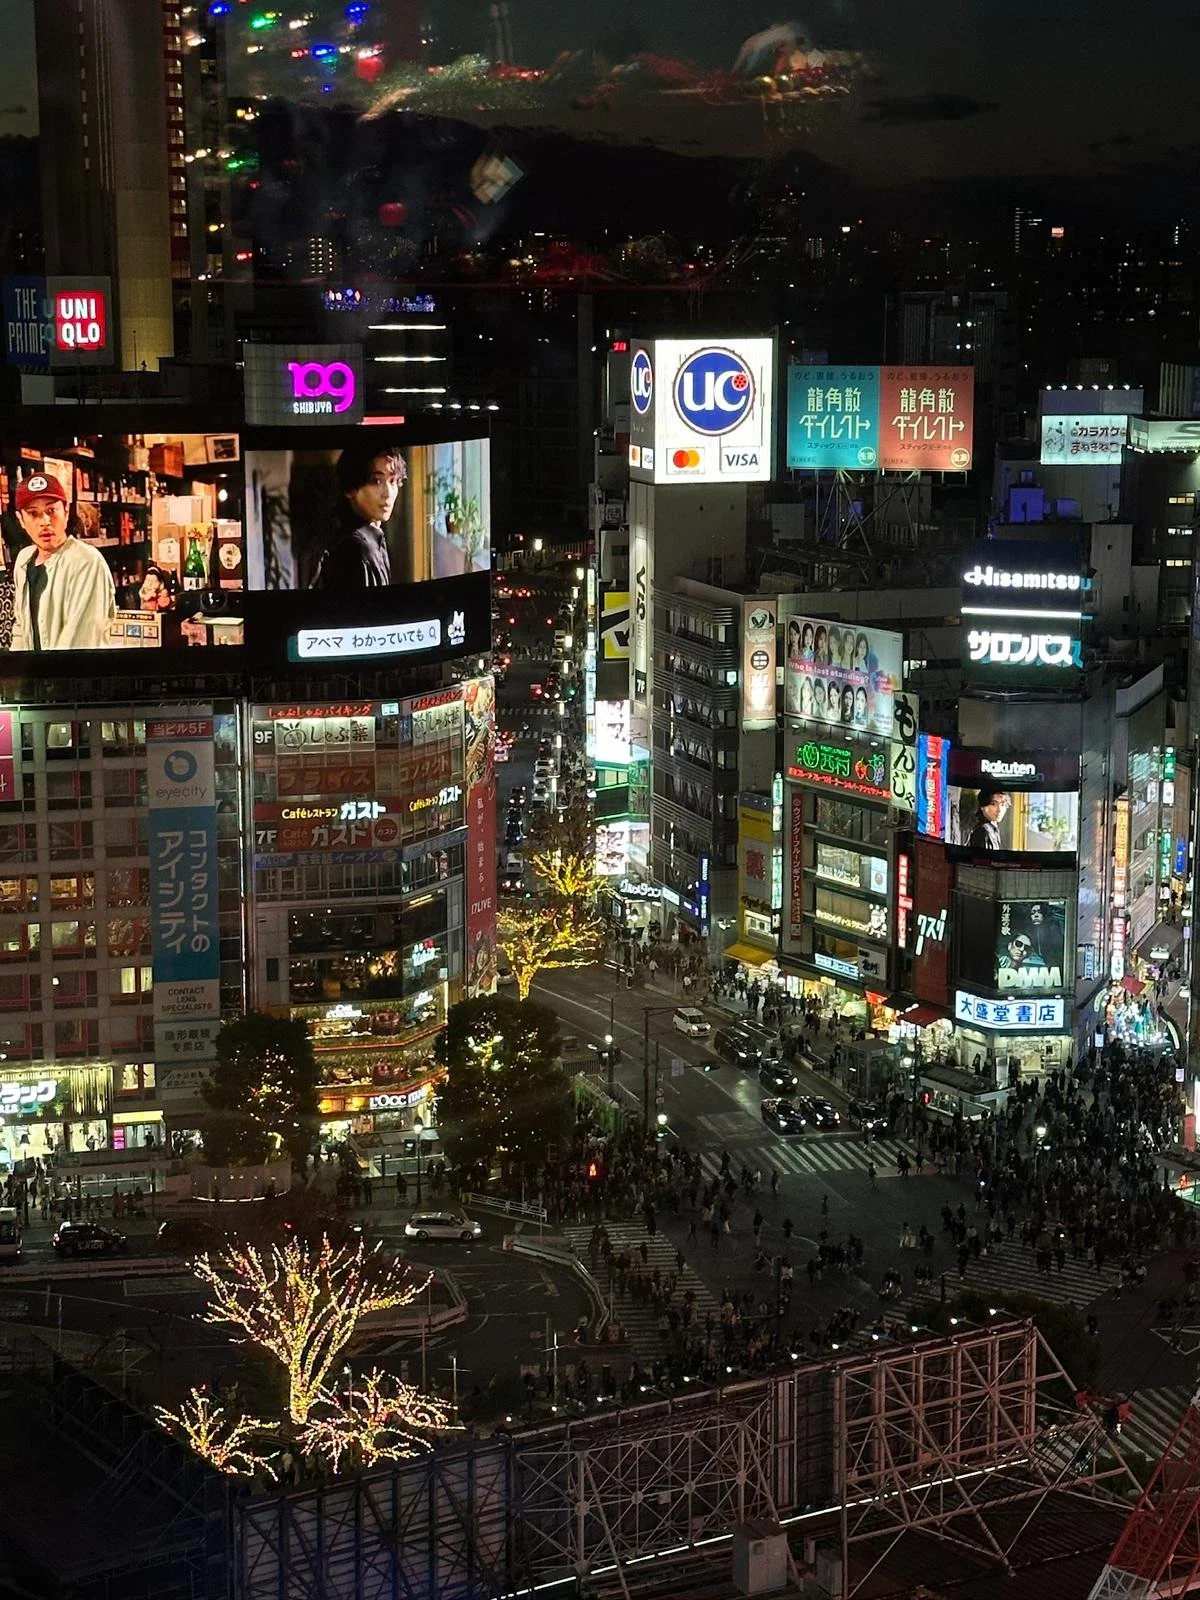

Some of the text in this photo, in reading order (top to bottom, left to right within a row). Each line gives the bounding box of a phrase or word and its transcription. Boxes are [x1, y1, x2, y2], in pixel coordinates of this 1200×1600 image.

[14, 287, 37, 320] THE
[60, 298, 97, 320] UNI
[8, 321, 47, 355] PRIME
[61, 321, 101, 347] QLO
[287, 361, 356, 413] 109
[683, 370, 747, 412] UC
[293, 400, 333, 414] SHIBUYA
[807, 387, 862, 412] 龍角散
[900, 388, 955, 413] 龍角散
[799, 414, 871, 440] ダイレクト
[892, 415, 965, 441] ダイレクト
[1078, 426, 1121, 437] カラオケ
[1070, 441, 1119, 454] まねきねこ
[725, 453, 759, 467] VISA
[964, 565, 1080, 590] Hisamitsu
[305, 627, 425, 650] アベマ わかっていても
[967, 630, 1073, 665] サロンパス
[153, 722, 207, 736] 当ビル5F
[254, 730, 272, 744] 9F
[310, 720, 369, 744] しゃぶ葉
[981, 759, 1036, 776] Rakuten
[156, 786, 208, 800] eyecity
[438, 785, 462, 807] ガスト
[340, 801, 386, 820] ガスト
[256, 829, 277, 845] 7F
[311, 825, 368, 848] ガスト
[158, 830, 188, 955] アイシティ
[189, 830, 211, 954] コンタクトの
[915, 908, 948, 957] クスリ
[998, 966, 1063, 989] DMM
[168, 986, 206, 997] CONTACT
[961, 997, 1057, 1023] 大盛堂書店
